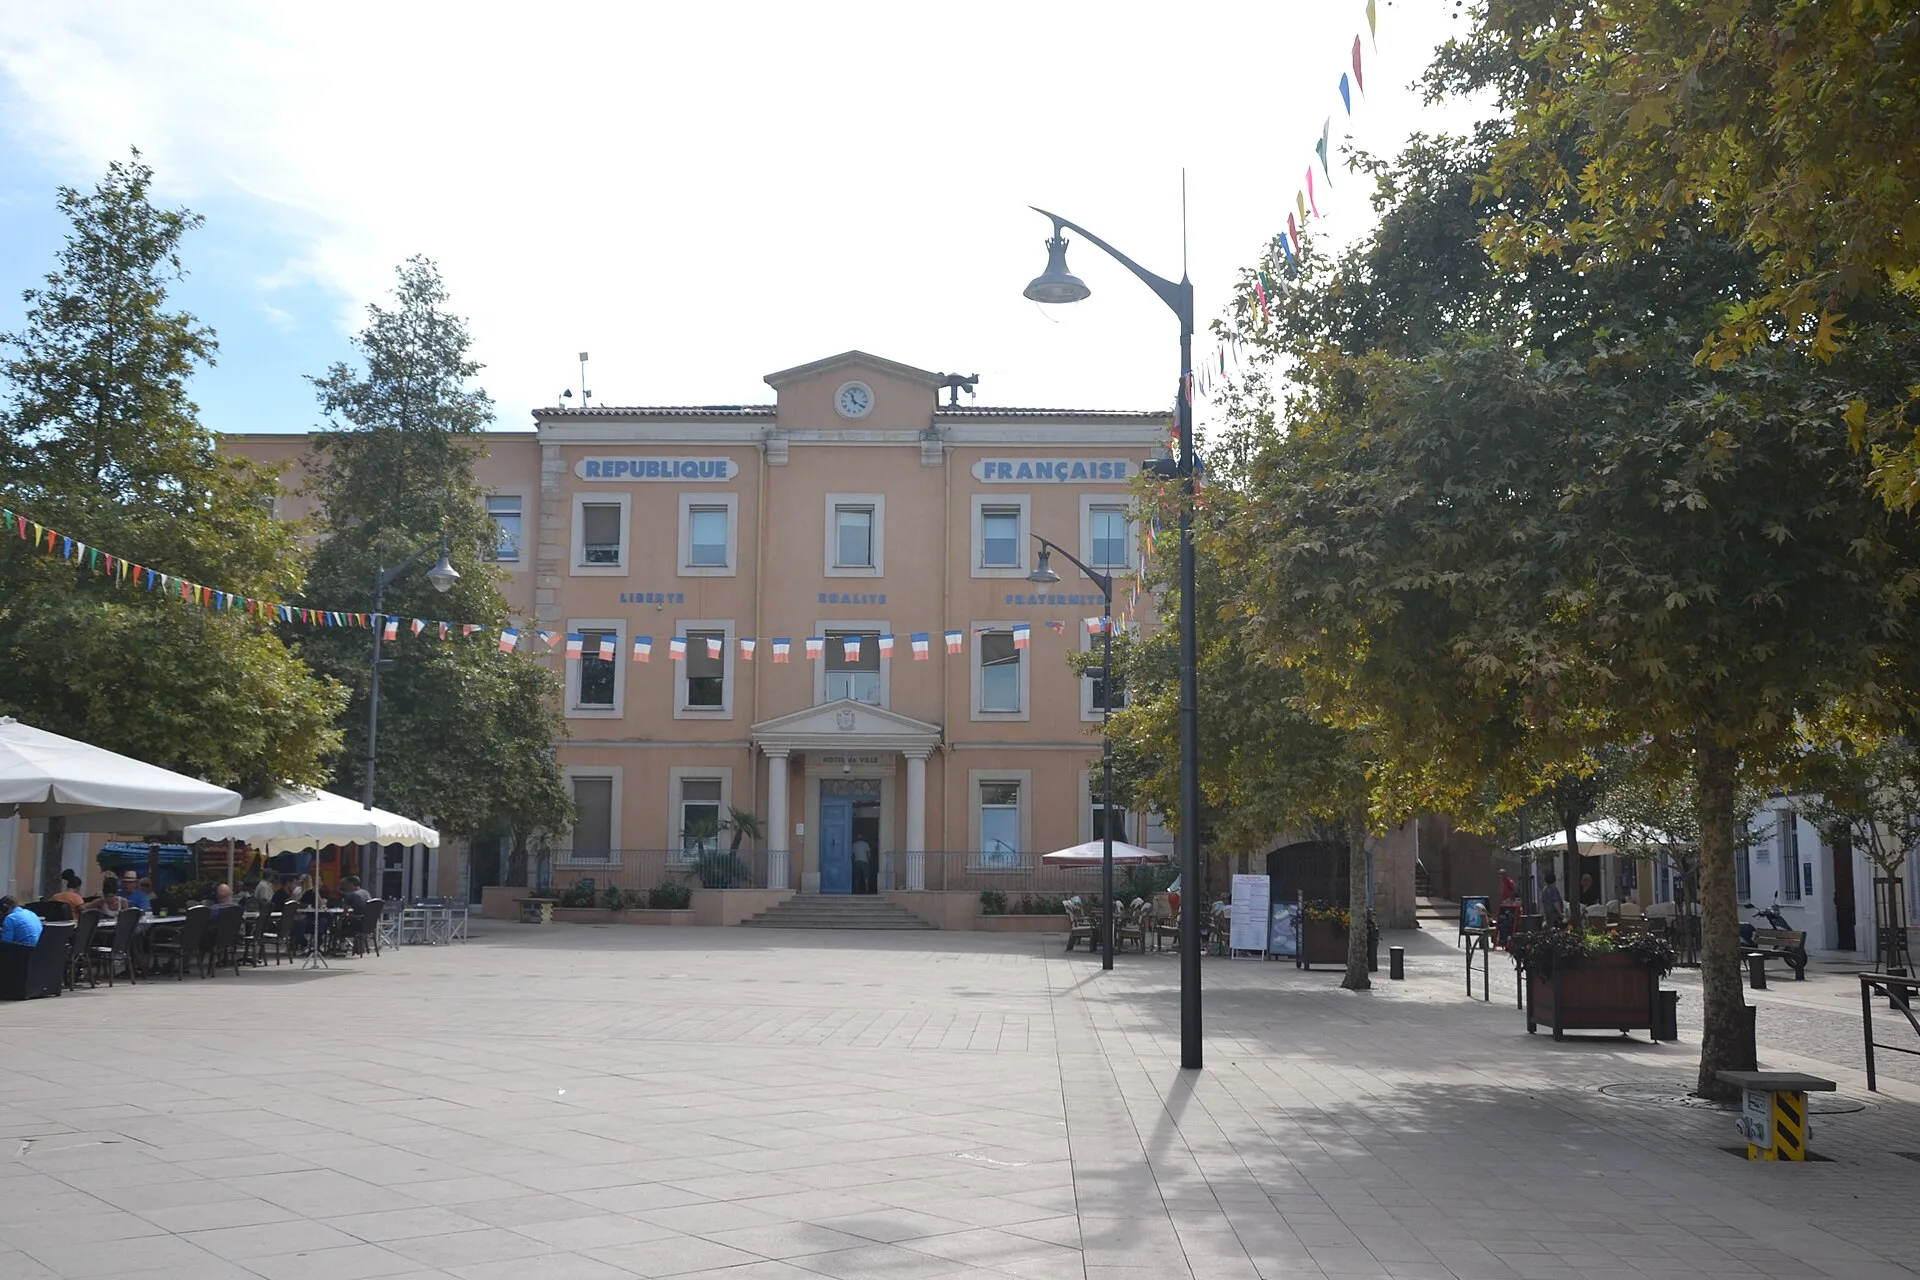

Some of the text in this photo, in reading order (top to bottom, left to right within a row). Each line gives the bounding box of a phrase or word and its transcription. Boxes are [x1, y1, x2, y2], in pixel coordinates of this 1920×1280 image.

[586, 460, 727, 478] REPUBLIQUE
[984, 462, 1126, 482] FRANÇAISE
[620, 592, 684, 604] LIBERTE
[818, 592, 886, 605] EGALITE
